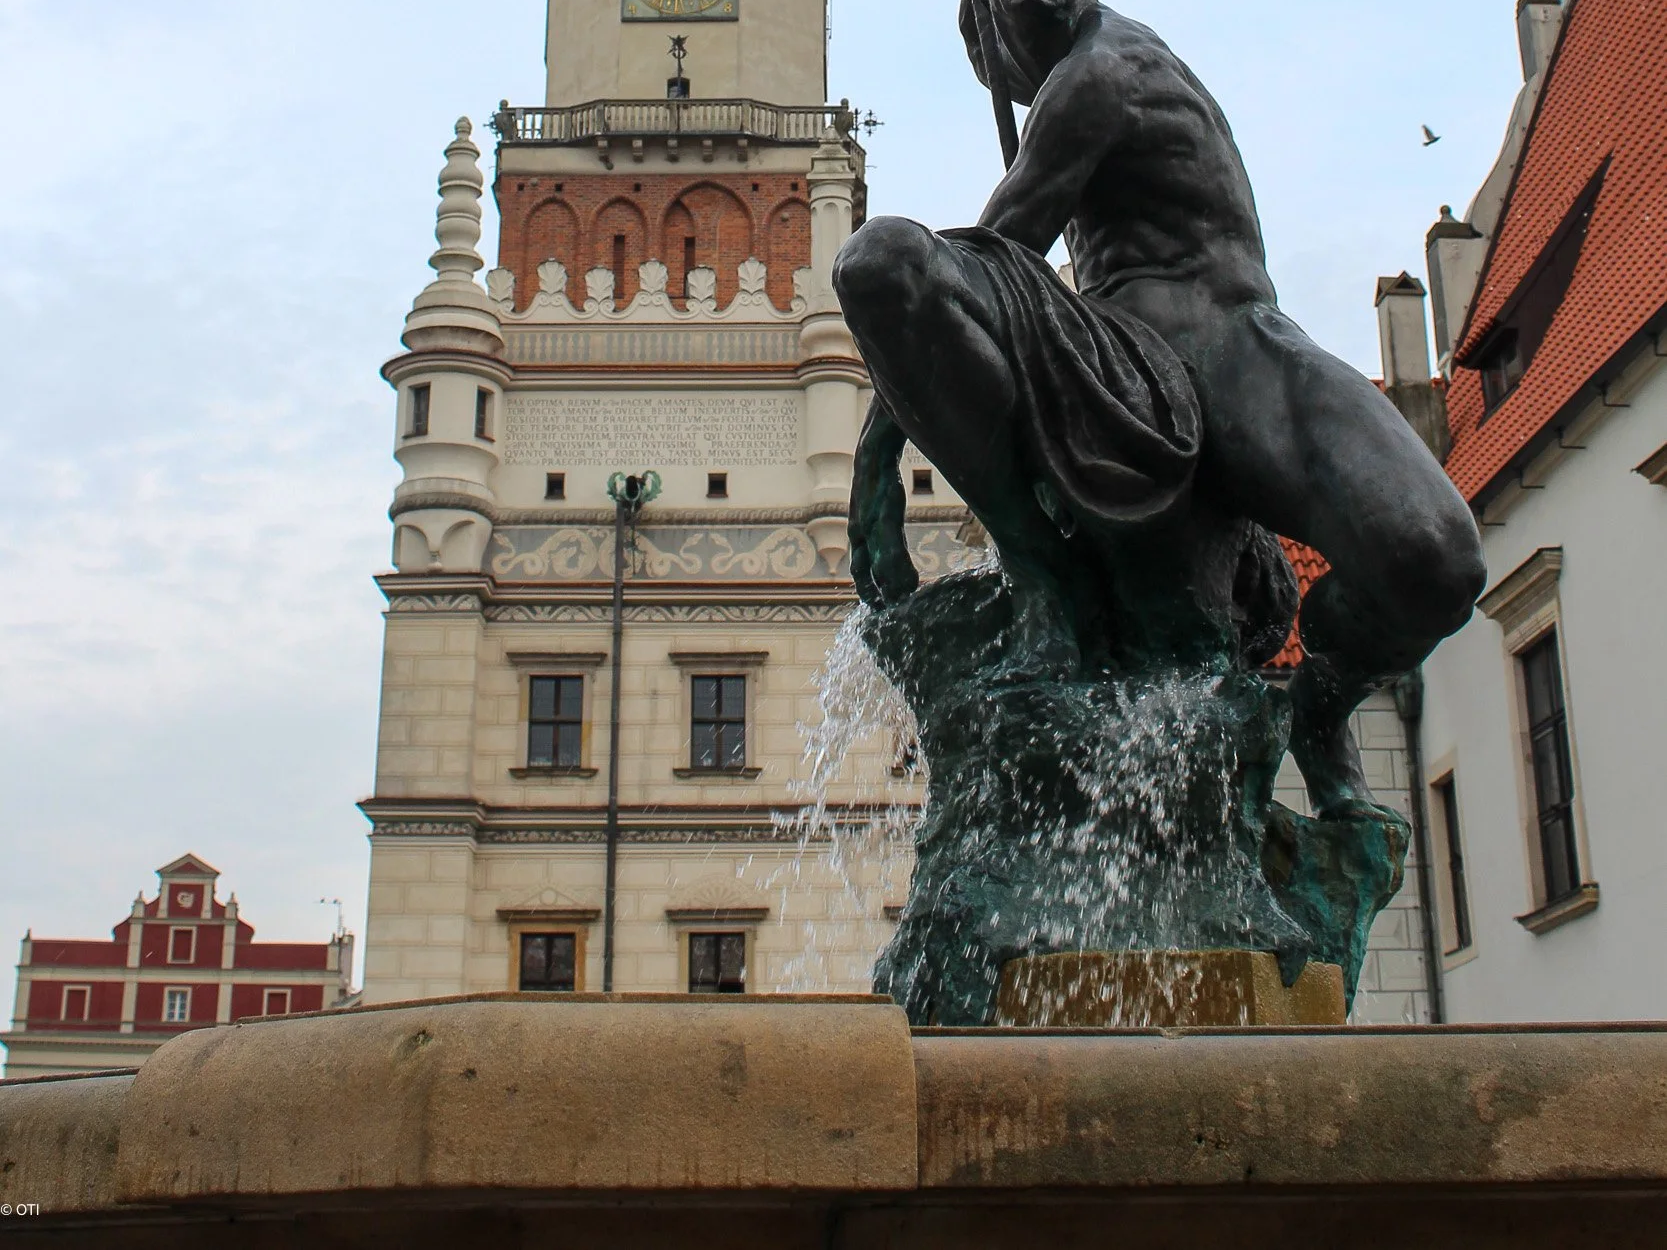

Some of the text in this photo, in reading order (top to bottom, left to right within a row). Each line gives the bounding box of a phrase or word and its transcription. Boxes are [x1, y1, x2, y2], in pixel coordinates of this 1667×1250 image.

[740, 399, 756, 408] QVI
[780, 408, 797, 416] QVI
[506, 424, 525, 433] QVE
[704, 433, 720, 442] QVI
[504, 450, 546, 458] QVANTO
